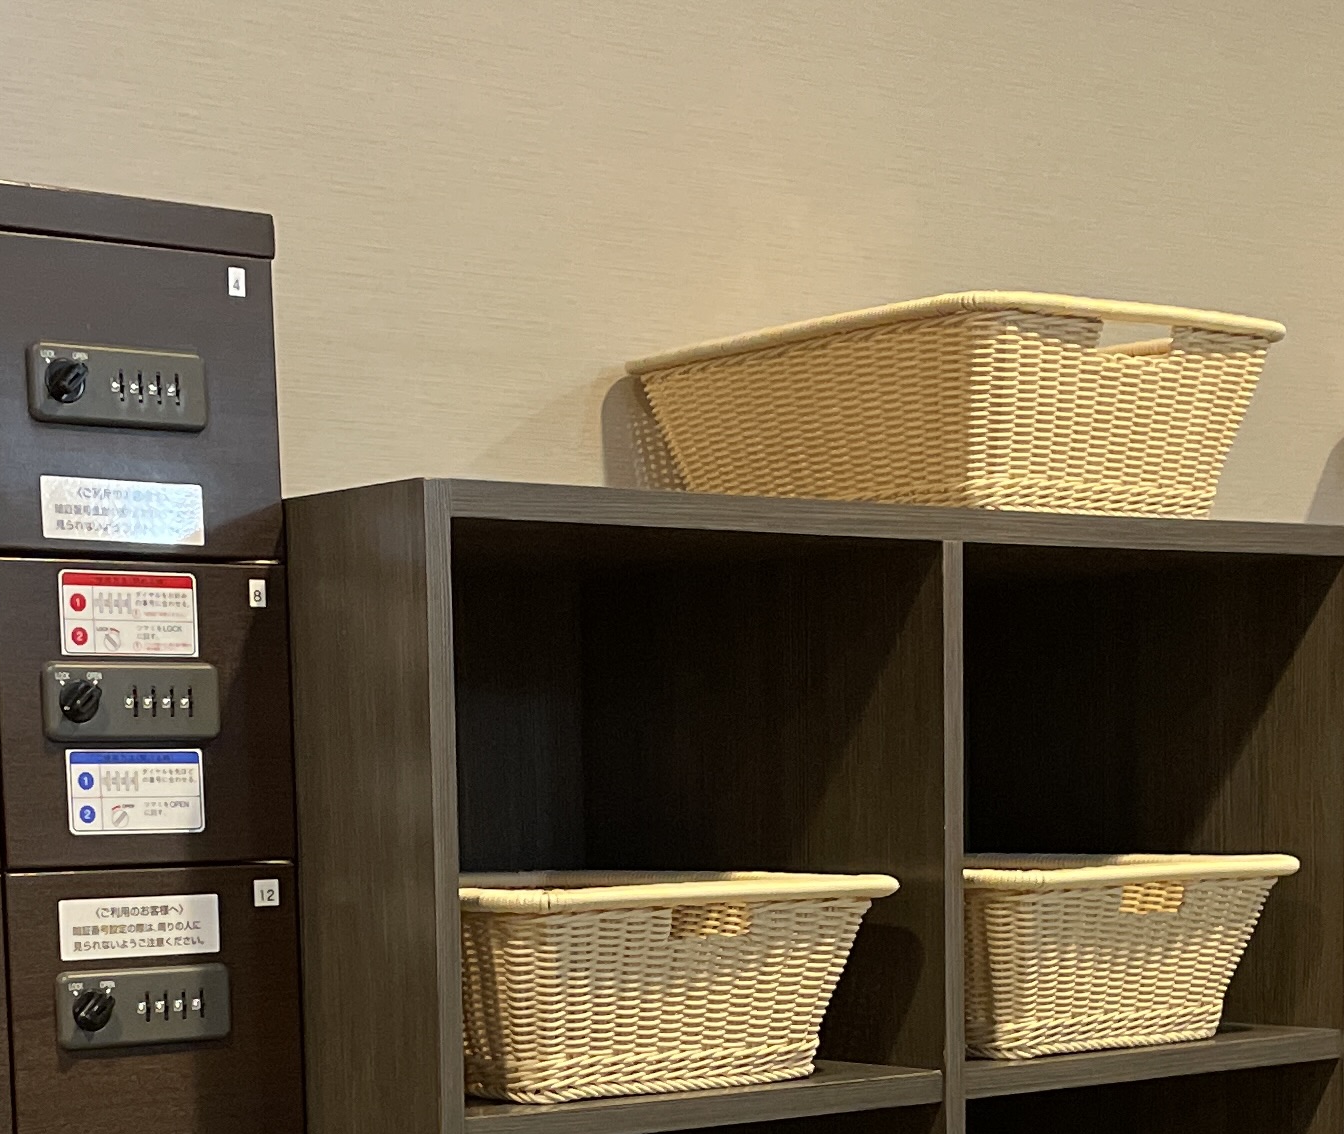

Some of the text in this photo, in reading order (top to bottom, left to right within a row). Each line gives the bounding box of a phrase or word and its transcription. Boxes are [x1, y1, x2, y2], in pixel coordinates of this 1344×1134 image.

[232, 279, 240, 291] 4
[254, 589, 262, 602] 8
[260, 889, 275, 902] 12
